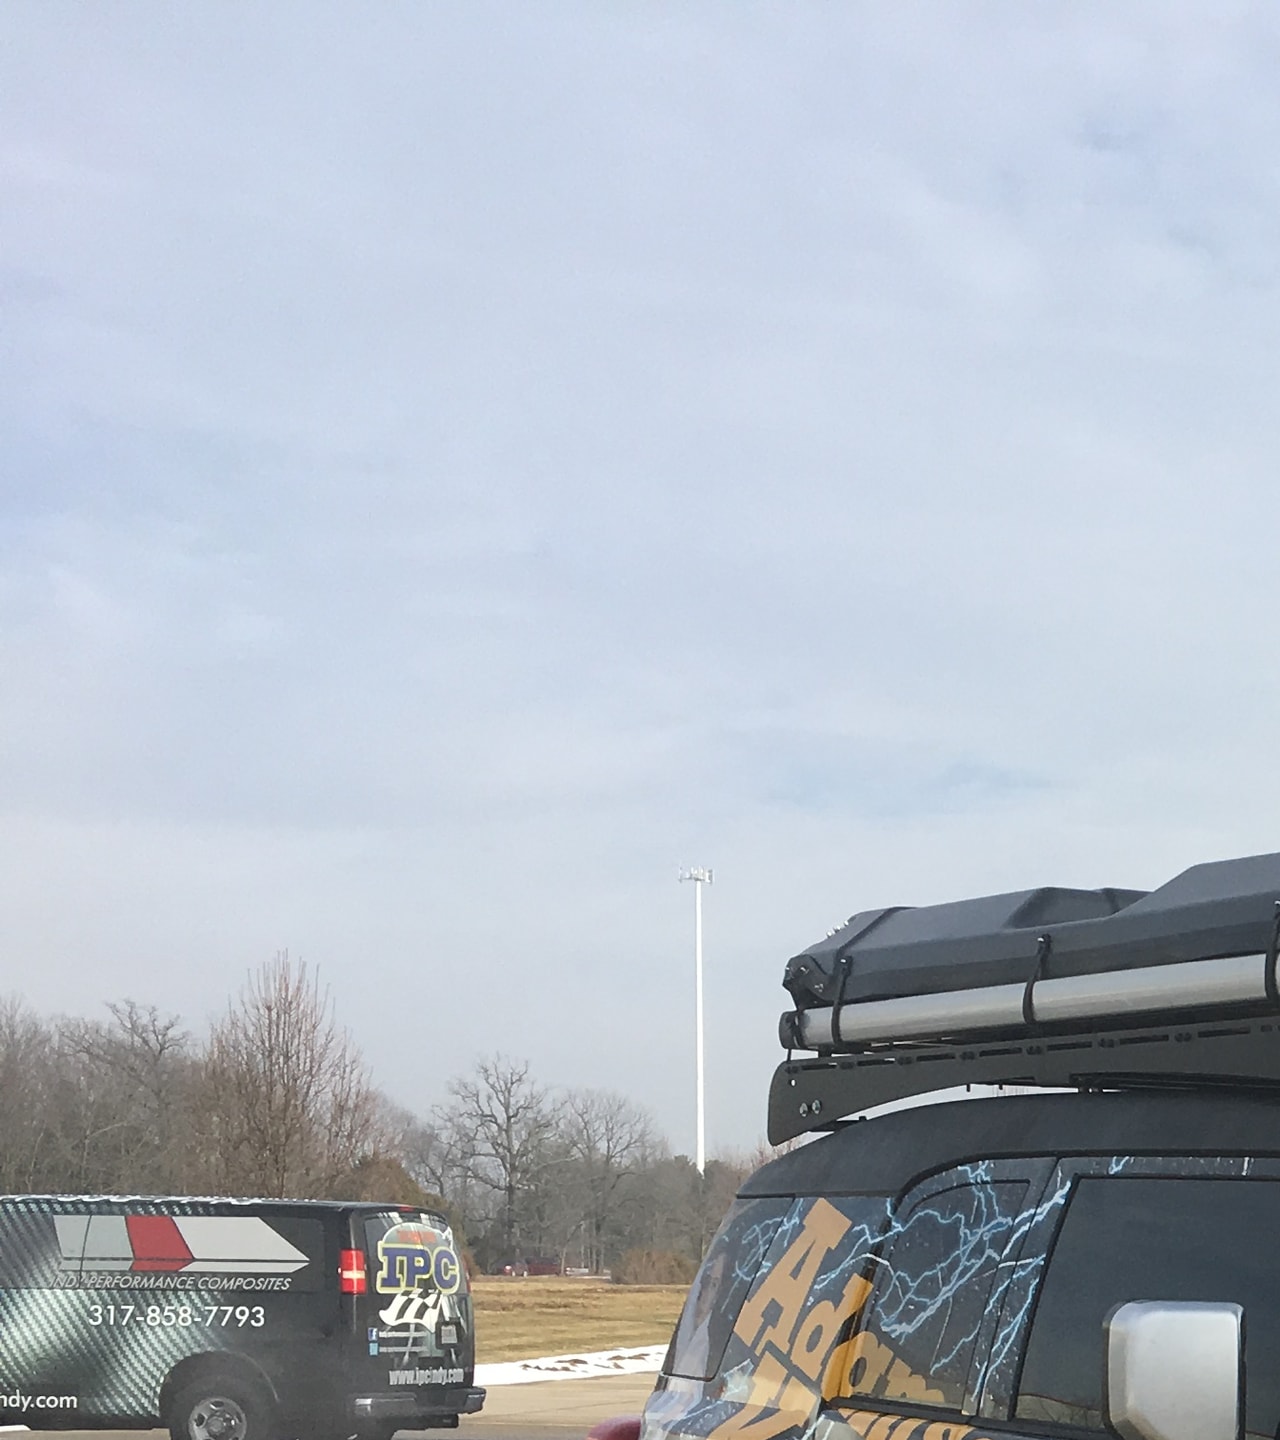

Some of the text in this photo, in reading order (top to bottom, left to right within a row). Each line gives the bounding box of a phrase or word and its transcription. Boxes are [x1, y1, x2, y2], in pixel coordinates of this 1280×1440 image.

[377, 1242, 460, 1293] IPC
[88, 1277, 195, 1290] PERFORMANCE
[198, 1277, 292, 1290] COMPOSITES
[89, 1305, 266, 1328] 317-858-7793
